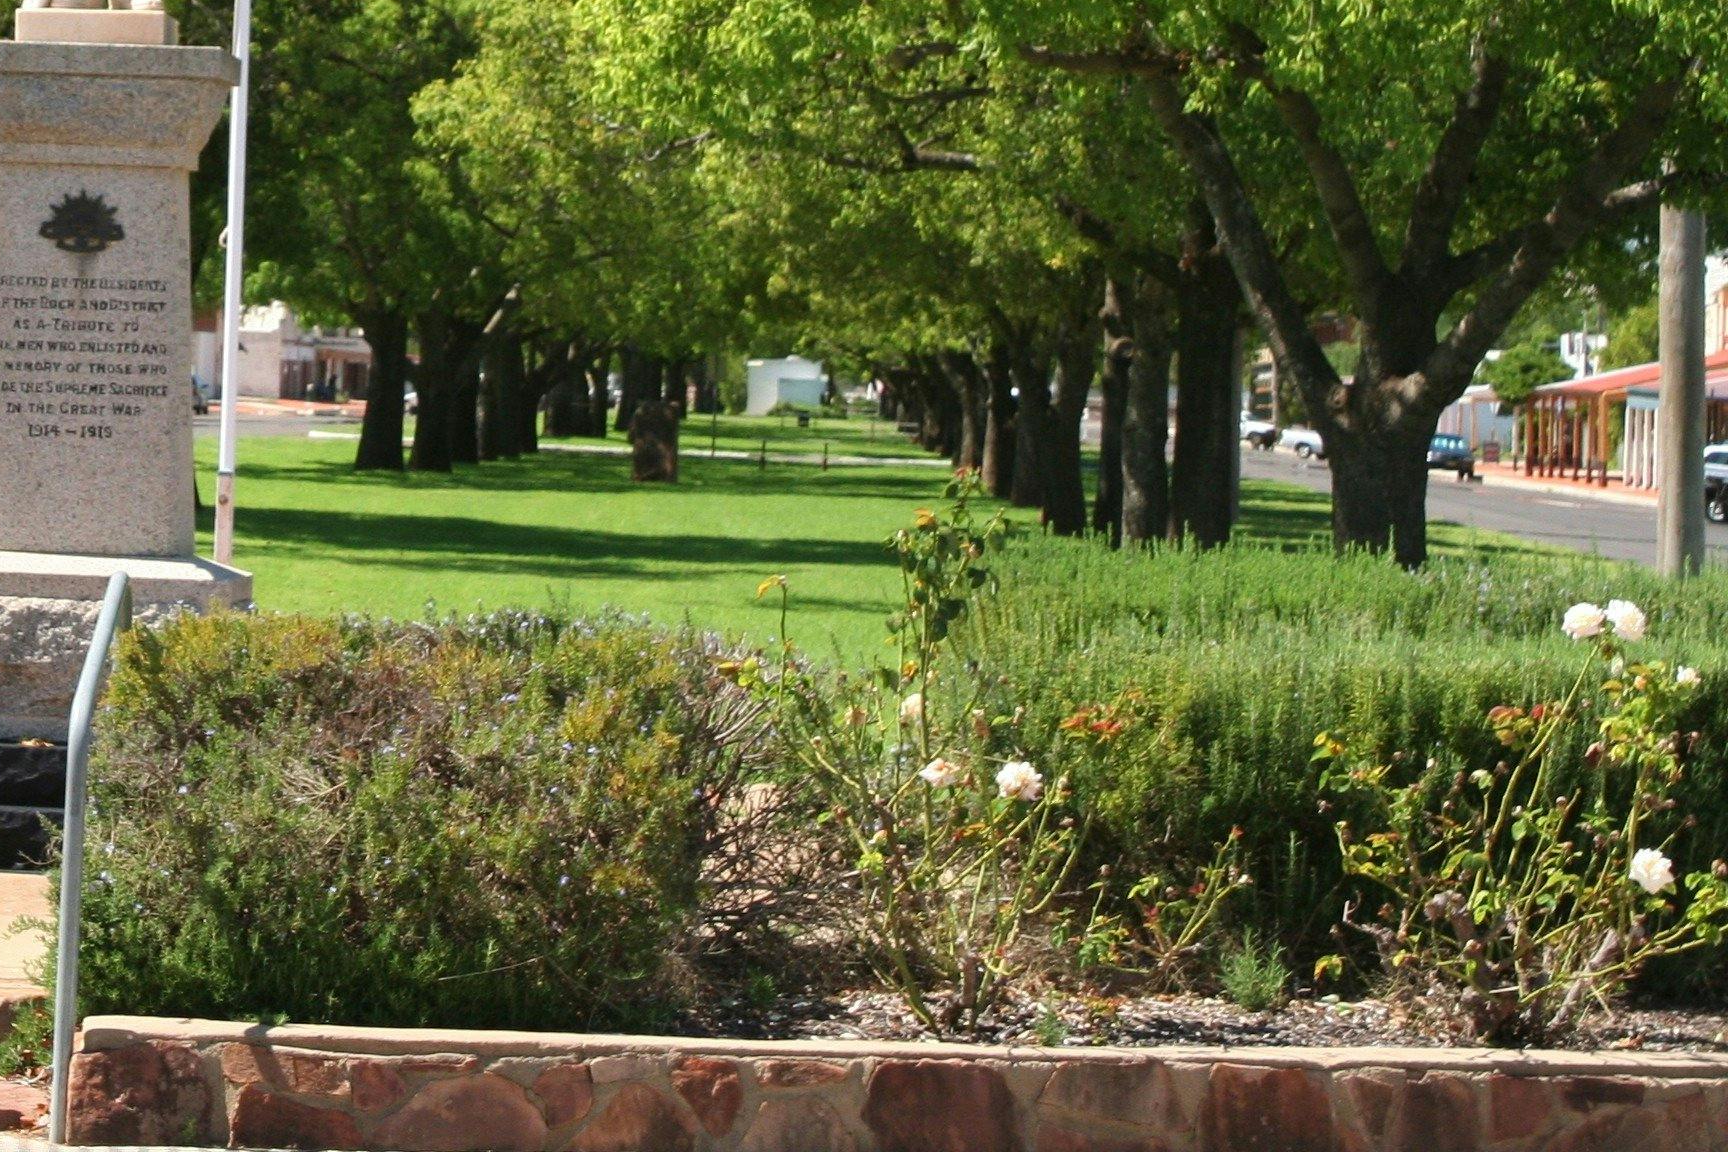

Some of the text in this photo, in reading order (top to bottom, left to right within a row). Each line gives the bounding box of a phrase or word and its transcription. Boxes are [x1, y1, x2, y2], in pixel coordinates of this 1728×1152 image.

[52, 277, 67, 288] BY
[73, 277, 96, 288] THE
[100, 277, 166, 291] RESIDENTS
[13, 297, 37, 309] THE
[40, 295, 75, 309] ROCK
[79, 299, 107, 310] AND
[110, 299, 167, 311] DISTRICT
[13, 318, 139, 331] AS A TRIBUTE TO
[17, 341, 43, 351] MEN
[47, 341, 75, 351] WHO
[80, 342, 139, 353] ENLISTED
[141, 344, 166, 354] AND
[5, 361, 62, 371] MEMORY
[66, 362, 81, 372] OF
[89, 363, 132, 374] THOSE
[138, 364, 167, 374] WHO
[20, 382, 43, 393] THE
[45, 381, 106, 394] SUPREME
[110, 382, 168, 396] SACRIFICE
[6, 402, 142, 416] IN THE GREAT WAR
[28, 423, 60, 437] 1914
